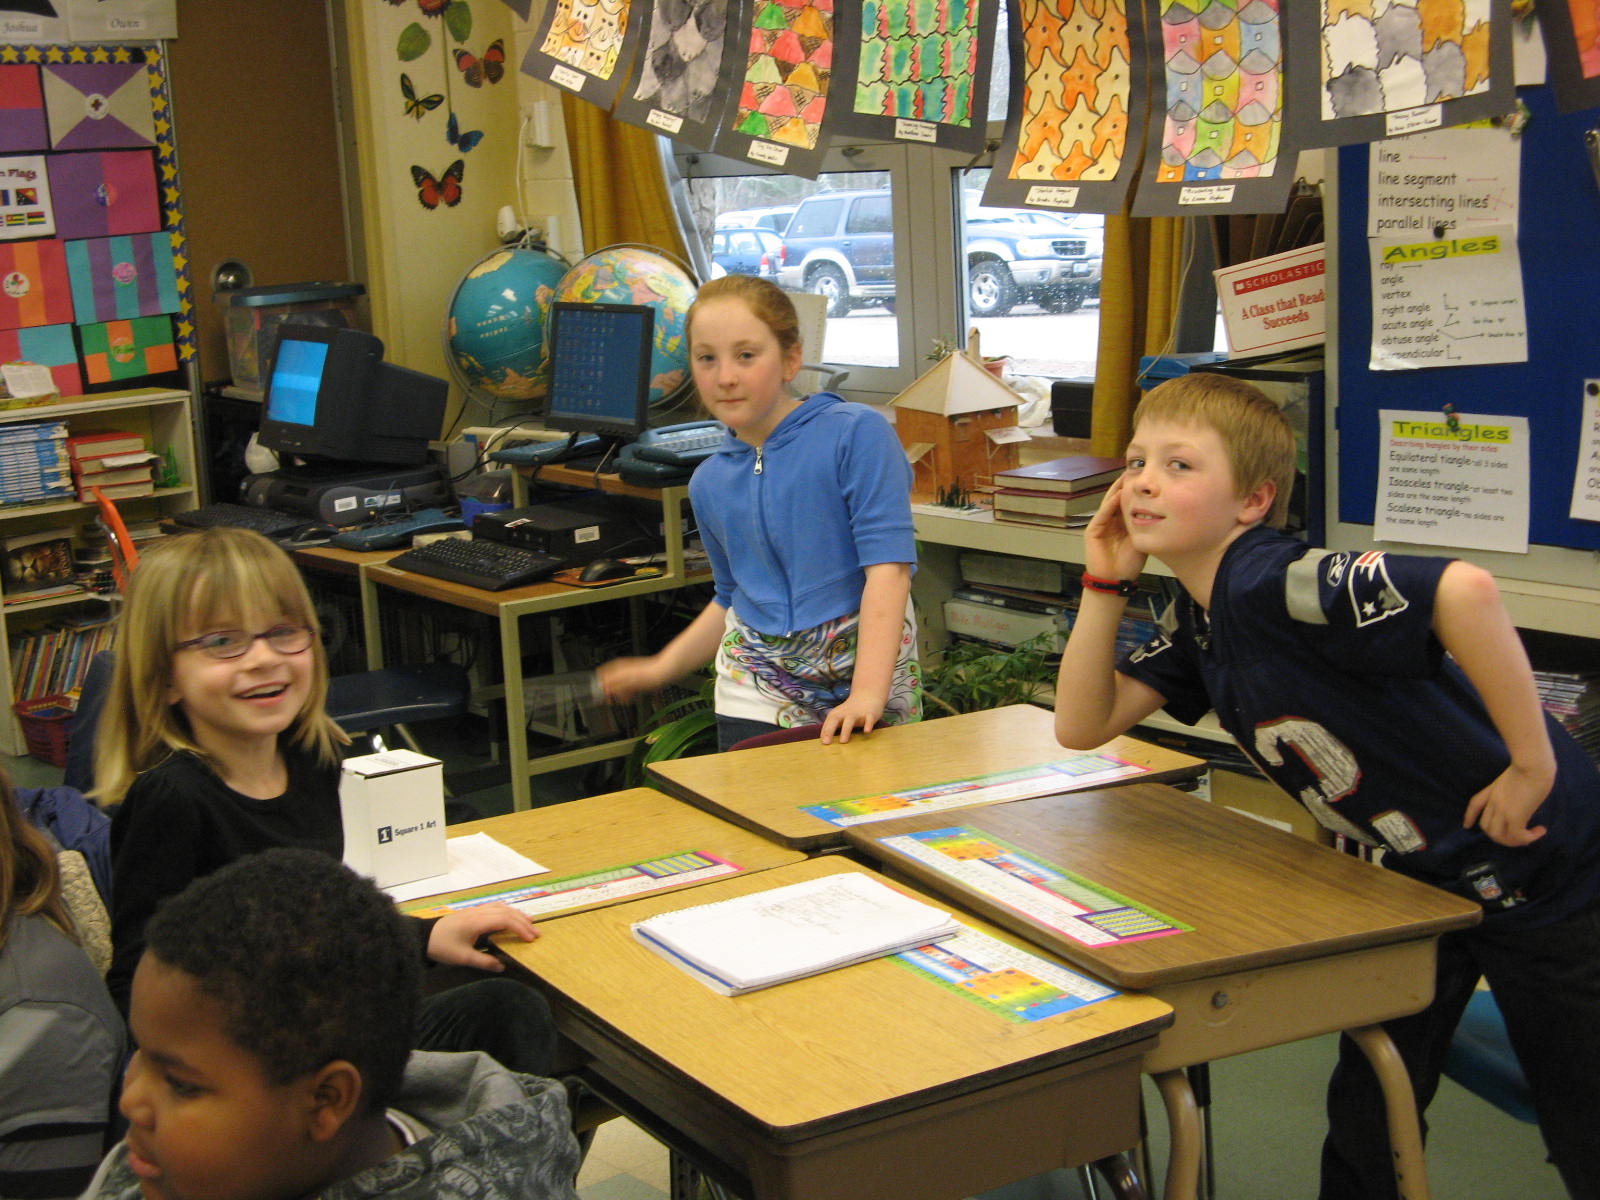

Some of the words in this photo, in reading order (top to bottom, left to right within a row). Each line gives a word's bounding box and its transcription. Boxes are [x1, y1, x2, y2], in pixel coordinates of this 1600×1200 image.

[1378, 149, 1401, 163] line
[8, 169, 37, 181] Flags
[1378, 171, 1400, 185] line
[1404, 172, 1457, 189] segment
[1378, 194, 1455, 212] intersecting
[1458, 194, 1489, 209] lines
[1377, 216, 1424, 233] parallel
[1427, 216, 1456, 230] lines
[1384, 239, 1498, 259] Angles
[1246, 262, 1325, 289] SCHOLASTIC
[1381, 274, 1405, 287] angle
[1382, 290, 1411, 300] vertex
[1242, 307, 1250, 320] A
[1250, 304, 1275, 318] Class
[1276, 297, 1297, 311] that
[1382, 304, 1405, 317] right
[1407, 303, 1432, 316] angle
[1263, 310, 1310, 330] Succeeds
[1382, 320, 1407, 330] acute
[1409, 317, 1434, 331] angle
[1381, 333, 1413, 345] obtuse
[1414, 333, 1439, 346] angle
[1381, 347, 1444, 360] rpendicular
[1392, 421, 1510, 442] Triangles
[1390, 451, 1437, 463] Equilateral
[1388, 476, 1431, 489] Isosceles
[1387, 502, 1422, 514] Scalene
[395, 826, 418, 836] Square
[427, 820, 437, 829] Art
